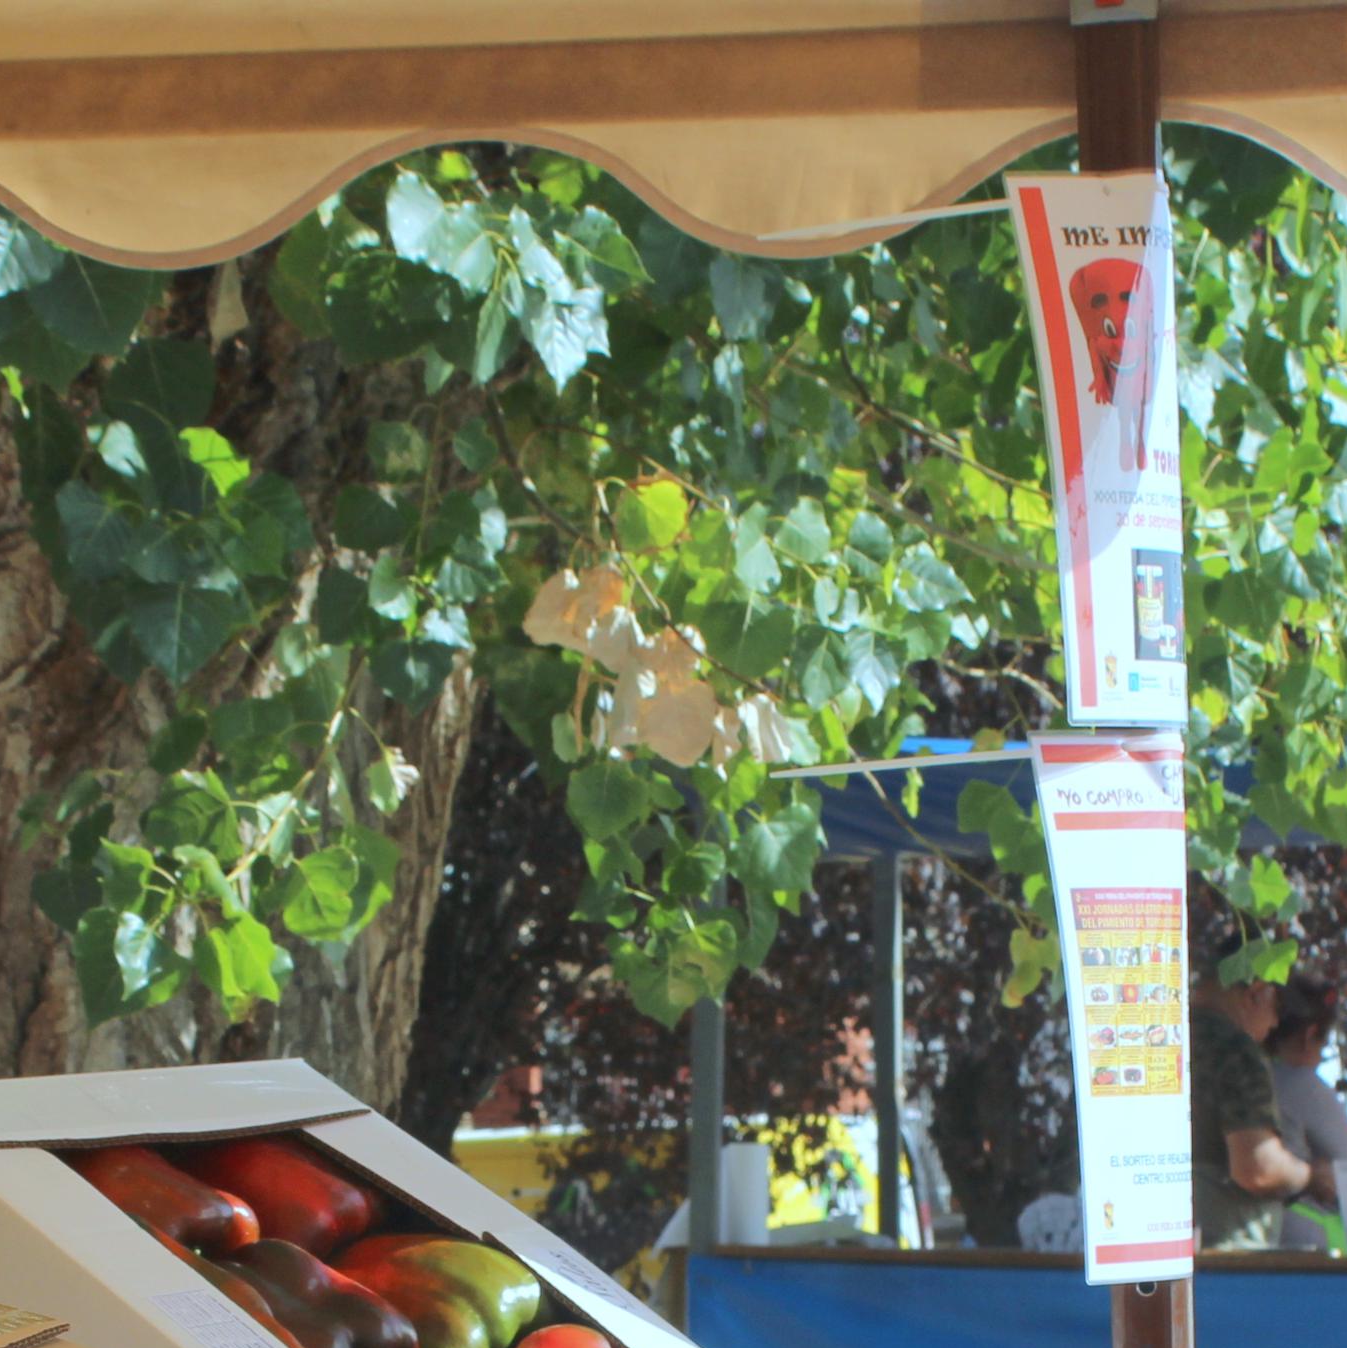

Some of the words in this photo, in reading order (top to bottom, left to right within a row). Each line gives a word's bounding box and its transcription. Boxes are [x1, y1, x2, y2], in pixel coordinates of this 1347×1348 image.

[1062, 226, 1109, 246] ME
[1110, 1155, 1119, 1168] EL
[1122, 1154, 1155, 1167] SORTEO
[1132, 1172, 1164, 1185] CENTRO
